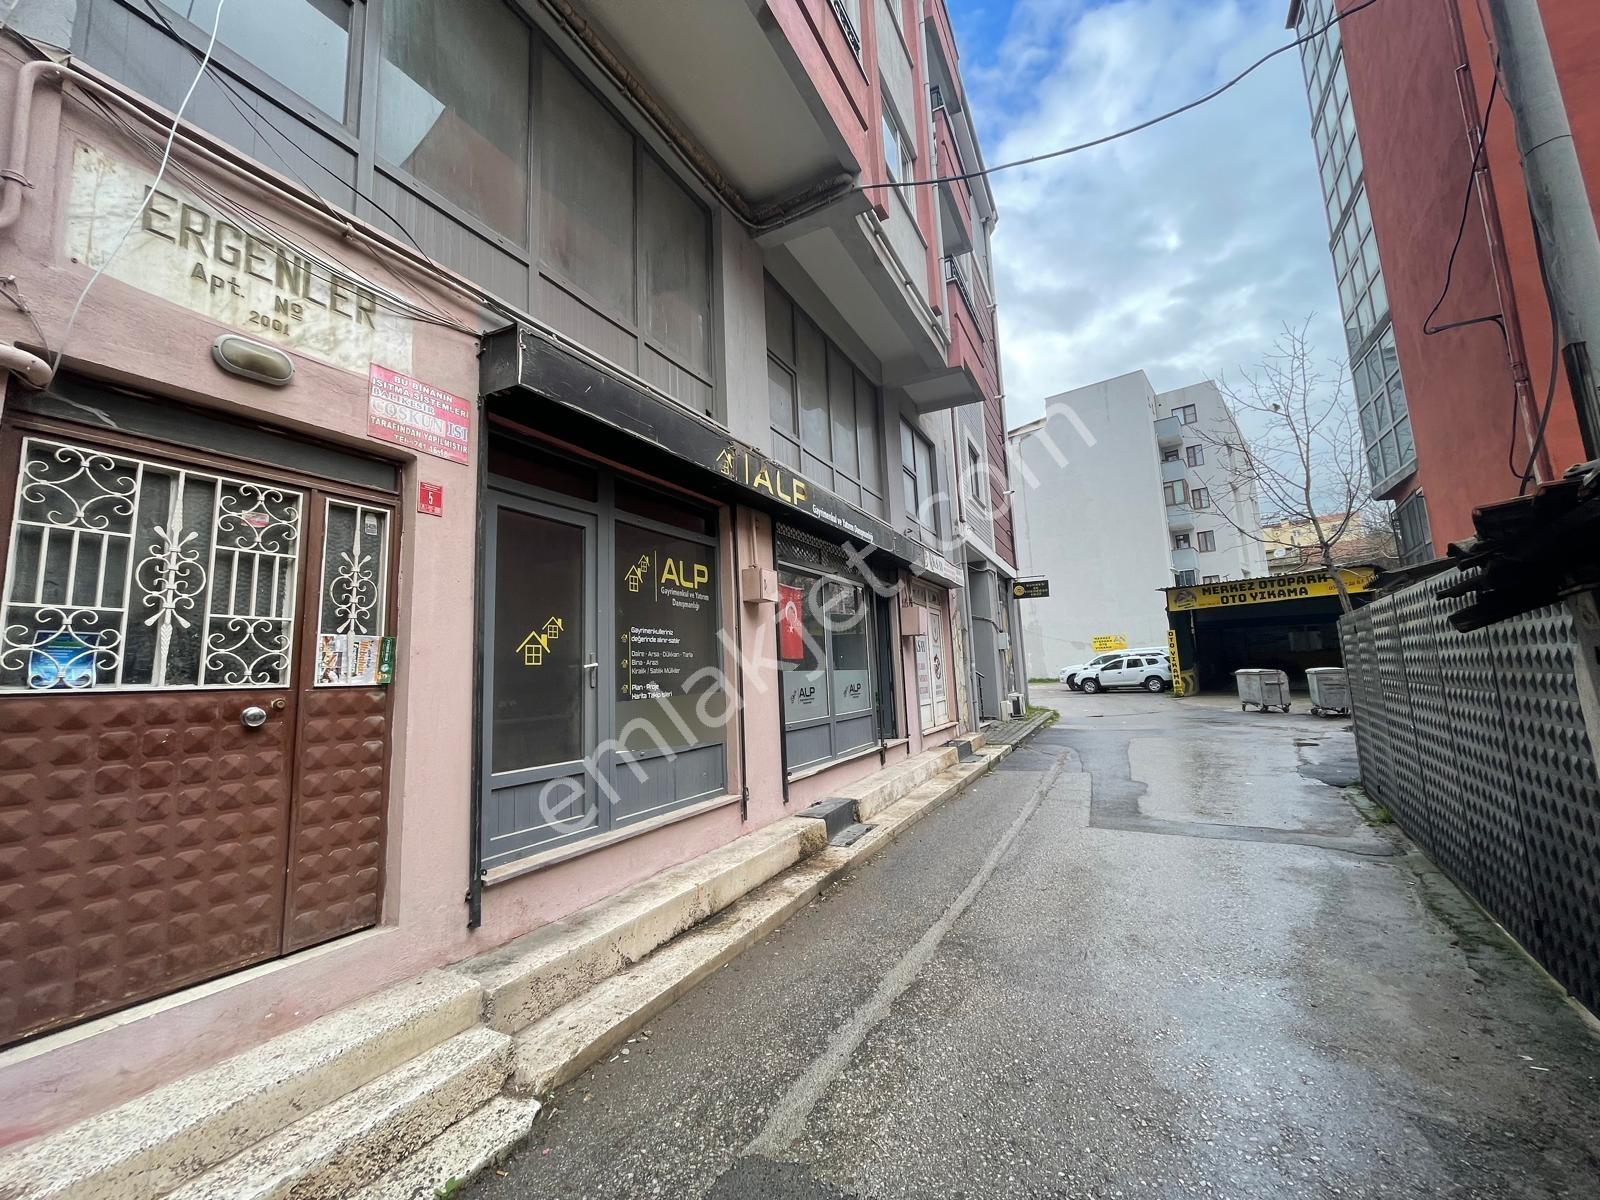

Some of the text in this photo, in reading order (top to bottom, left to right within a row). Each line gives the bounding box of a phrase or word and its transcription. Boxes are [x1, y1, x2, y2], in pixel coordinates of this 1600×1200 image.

[142, 185, 377, 330] ERGENLER
[249, 311, 290, 337] 2001
[372, 378, 410, 398] ISITMA
[394, 375, 454, 403] BU BİNANIN
[370, 415, 422, 439] TARAFINDAN
[428, 491, 434, 505] 5
[660, 557, 709, 590] ALP
[1202, 581, 1256, 596] MERKEZ
[1257, 573, 1329, 591] OTOPARK
[1220, 586, 1310, 605] OTO YIKAMA
[1167, 631, 1181, 686] OTO YIKAMA
[799, 686, 816, 699] ALP
[849, 683, 862, 694] ALP
